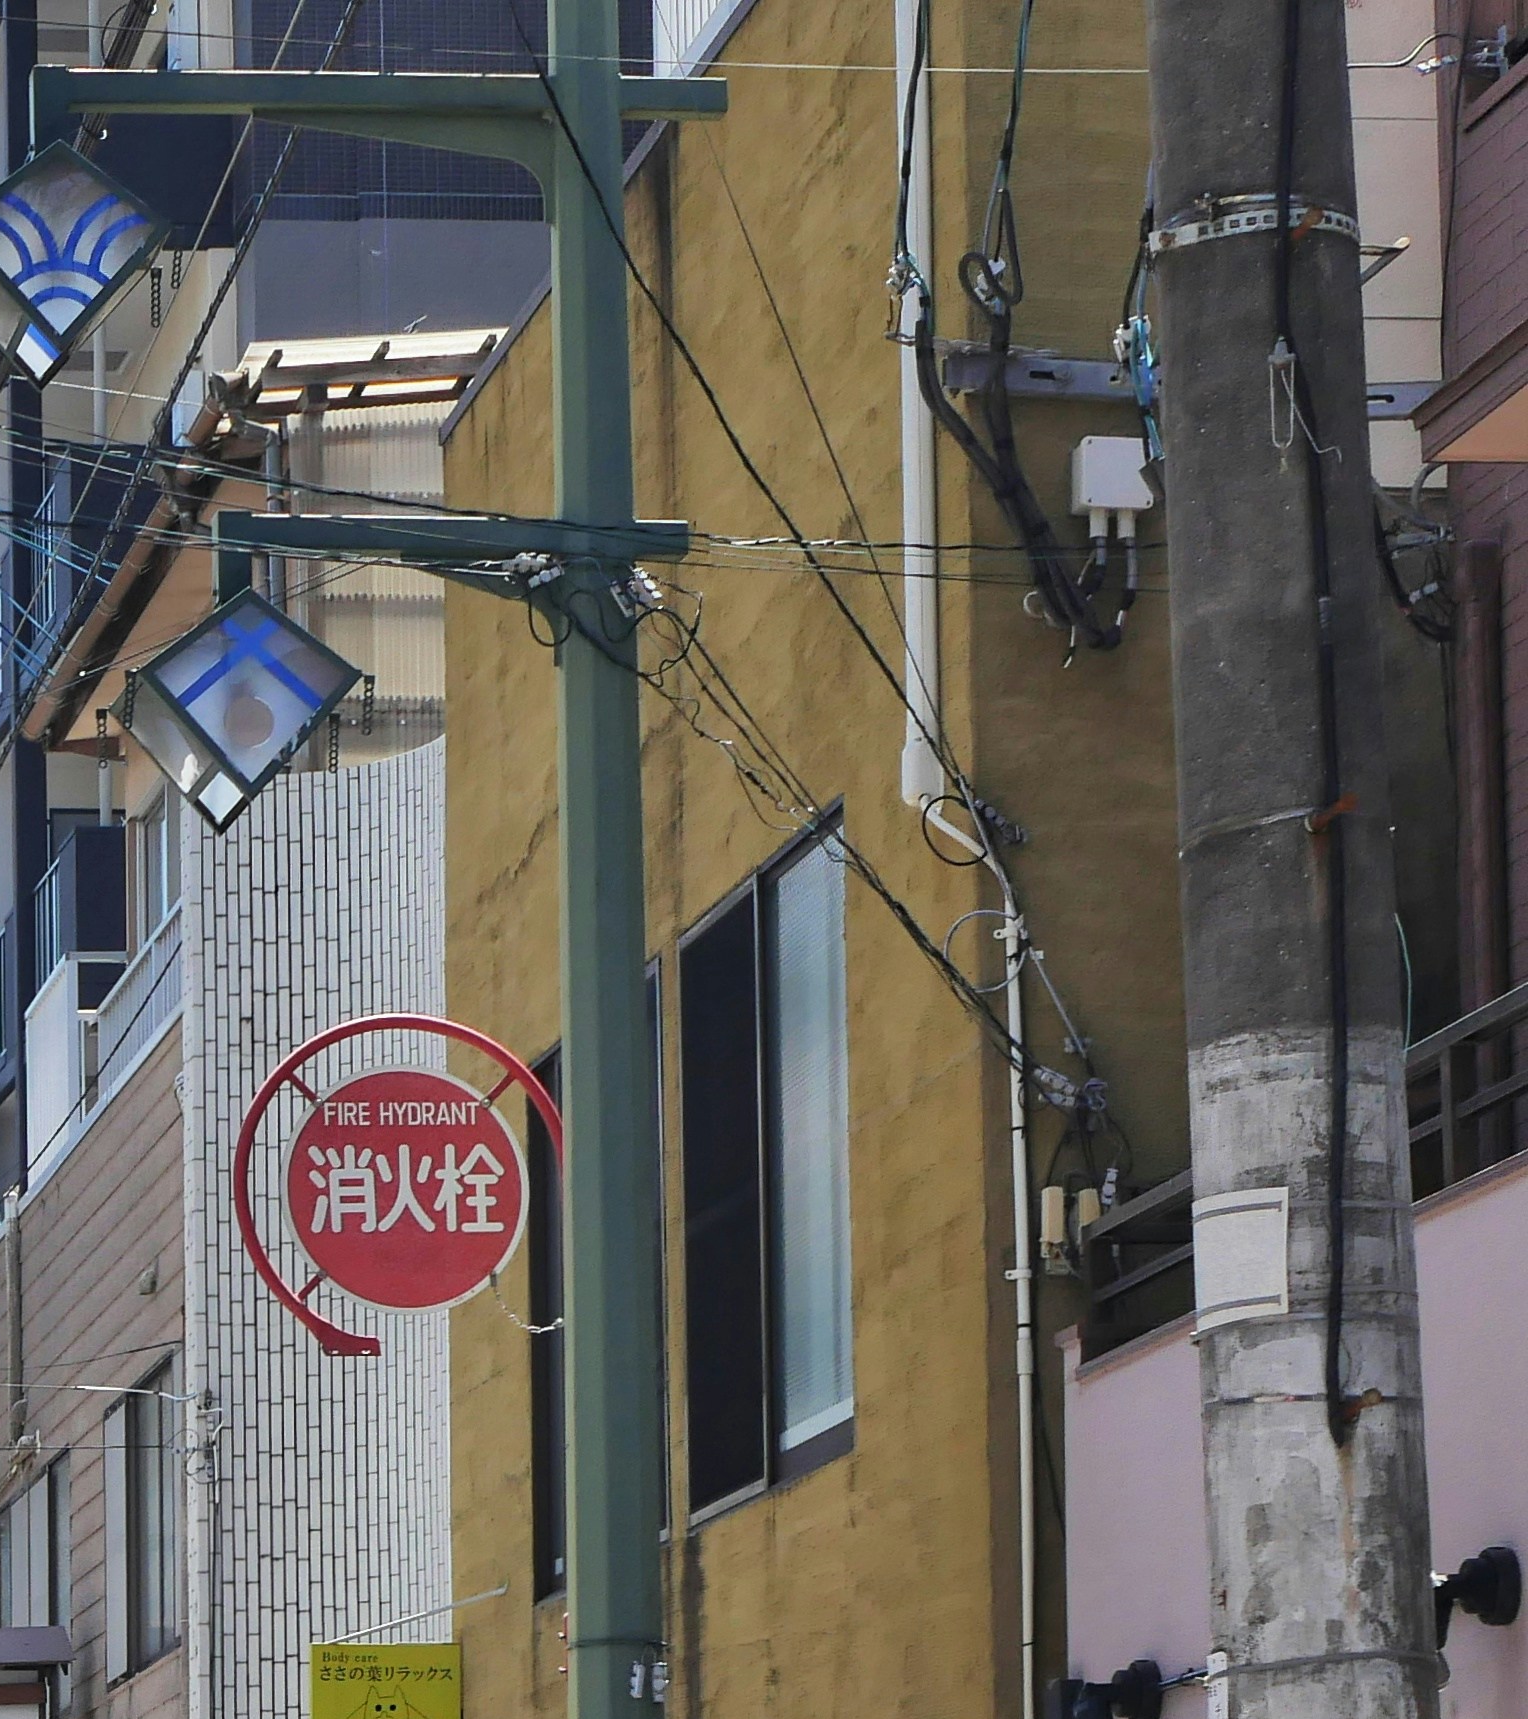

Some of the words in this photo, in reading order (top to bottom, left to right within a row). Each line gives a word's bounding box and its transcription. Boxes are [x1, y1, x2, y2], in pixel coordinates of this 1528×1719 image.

[323, 1101, 370, 1126] FIRE
[379, 1101, 481, 1126] HYDRANT
[308, 1143, 505, 1233] 消火栓
[322, 1652, 349, 1664] Body
[355, 1653, 379, 1663] care
[319, 1665, 452, 1682] ささの葉リラックス
